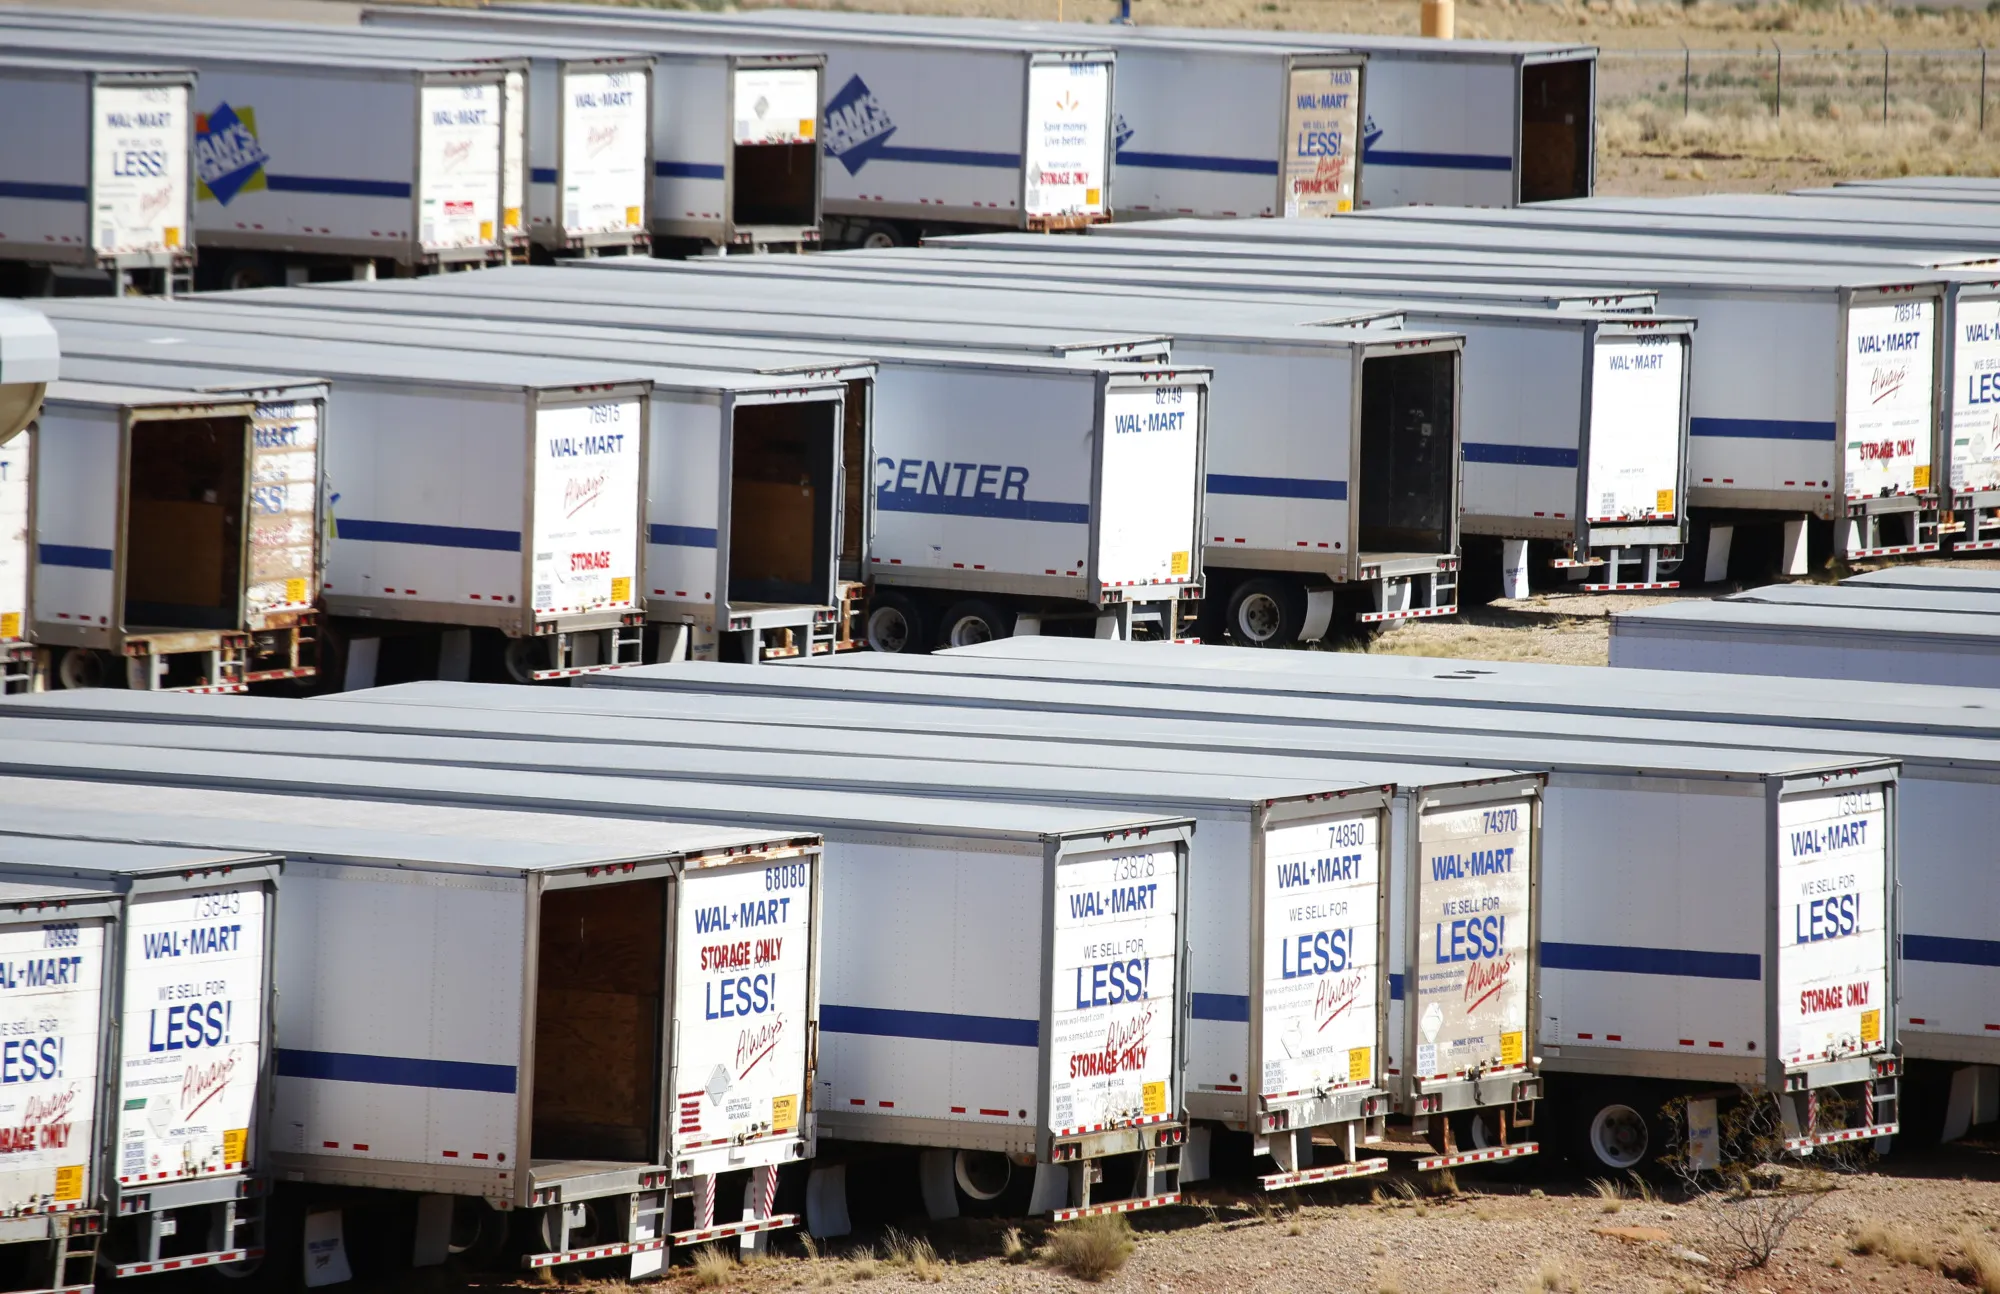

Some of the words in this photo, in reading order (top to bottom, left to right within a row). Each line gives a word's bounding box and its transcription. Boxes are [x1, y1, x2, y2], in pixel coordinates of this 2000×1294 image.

[1298, 132, 1342, 157] LESS!
[113, 152, 168, 177] LESS!
[1040, 171, 1070, 185] STORAGE
[1073, 171, 1089, 185] ONLY
[1294, 179, 1322, 194] STORAGE
[1324, 178, 1340, 193] ONLY
[1895, 303, 1921, 322] 78514
[1156, 386, 1182, 405] 62149
[1860, 441, 1894, 461] STORAGE
[1897, 439, 1915, 457] ONLY
[876, 457, 1030, 501] CENTER
[571, 552, 611, 571] STORAGE
[1836, 789, 1872, 817] 73914
[1483, 809, 1517, 834] 74370
[1329, 822, 1364, 849] 74850
[765, 864, 805, 891] 68080
[1112, 853, 1155, 881] 73878
[1801, 881, 1814, 896] WE
[1816, 878, 1836, 893] SELL
[1839, 874, 1856, 890] FOR
[192, 890, 240, 918] 73843
[1289, 908, 1303, 922] WE
[1305, 905, 1327, 920] SELL
[1330, 901, 1348, 916] FOR
[1443, 902, 1456, 915] WE
[1459, 899, 1480, 914] SELL
[1482, 896, 1500, 911] FOR
[1796, 893, 1860, 945] LESS!
[1084, 945, 1098, 959] WE
[1100, 942, 1123, 958] SELL
[1126, 938, 1144, 954] FOR
[1436, 915, 1505, 964] LESS!
[701, 941, 751, 971] STORAGE
[755, 937, 783, 963] ONLY
[1282, 926, 1353, 980] LESS!
[158, 986, 175, 1001] WE
[177, 983, 202, 999] SELL
[205, 980, 226, 996] FOR
[1076, 957, 1150, 1010] LESS!
[706, 973, 776, 1020] LESS!
[1801, 986, 1842, 1015] STORAGE
[1846, 981, 1870, 1008] ONLY
[148, 1000, 232, 1053] LESS!
[1302, 1049, 1315, 1058] HOME
[1316, 1046, 1334, 1055] OFFICE
[1453, 1038, 1466, 1047] HOME
[1468, 1036, 1484, 1045] OFFICE
[1070, 1049, 1118, 1079] STORAGE
[1121, 1046, 1147, 1072] ONLY
[773, 1100, 790, 1109] CAUTION
[40, 1123, 72, 1149] ONLY
